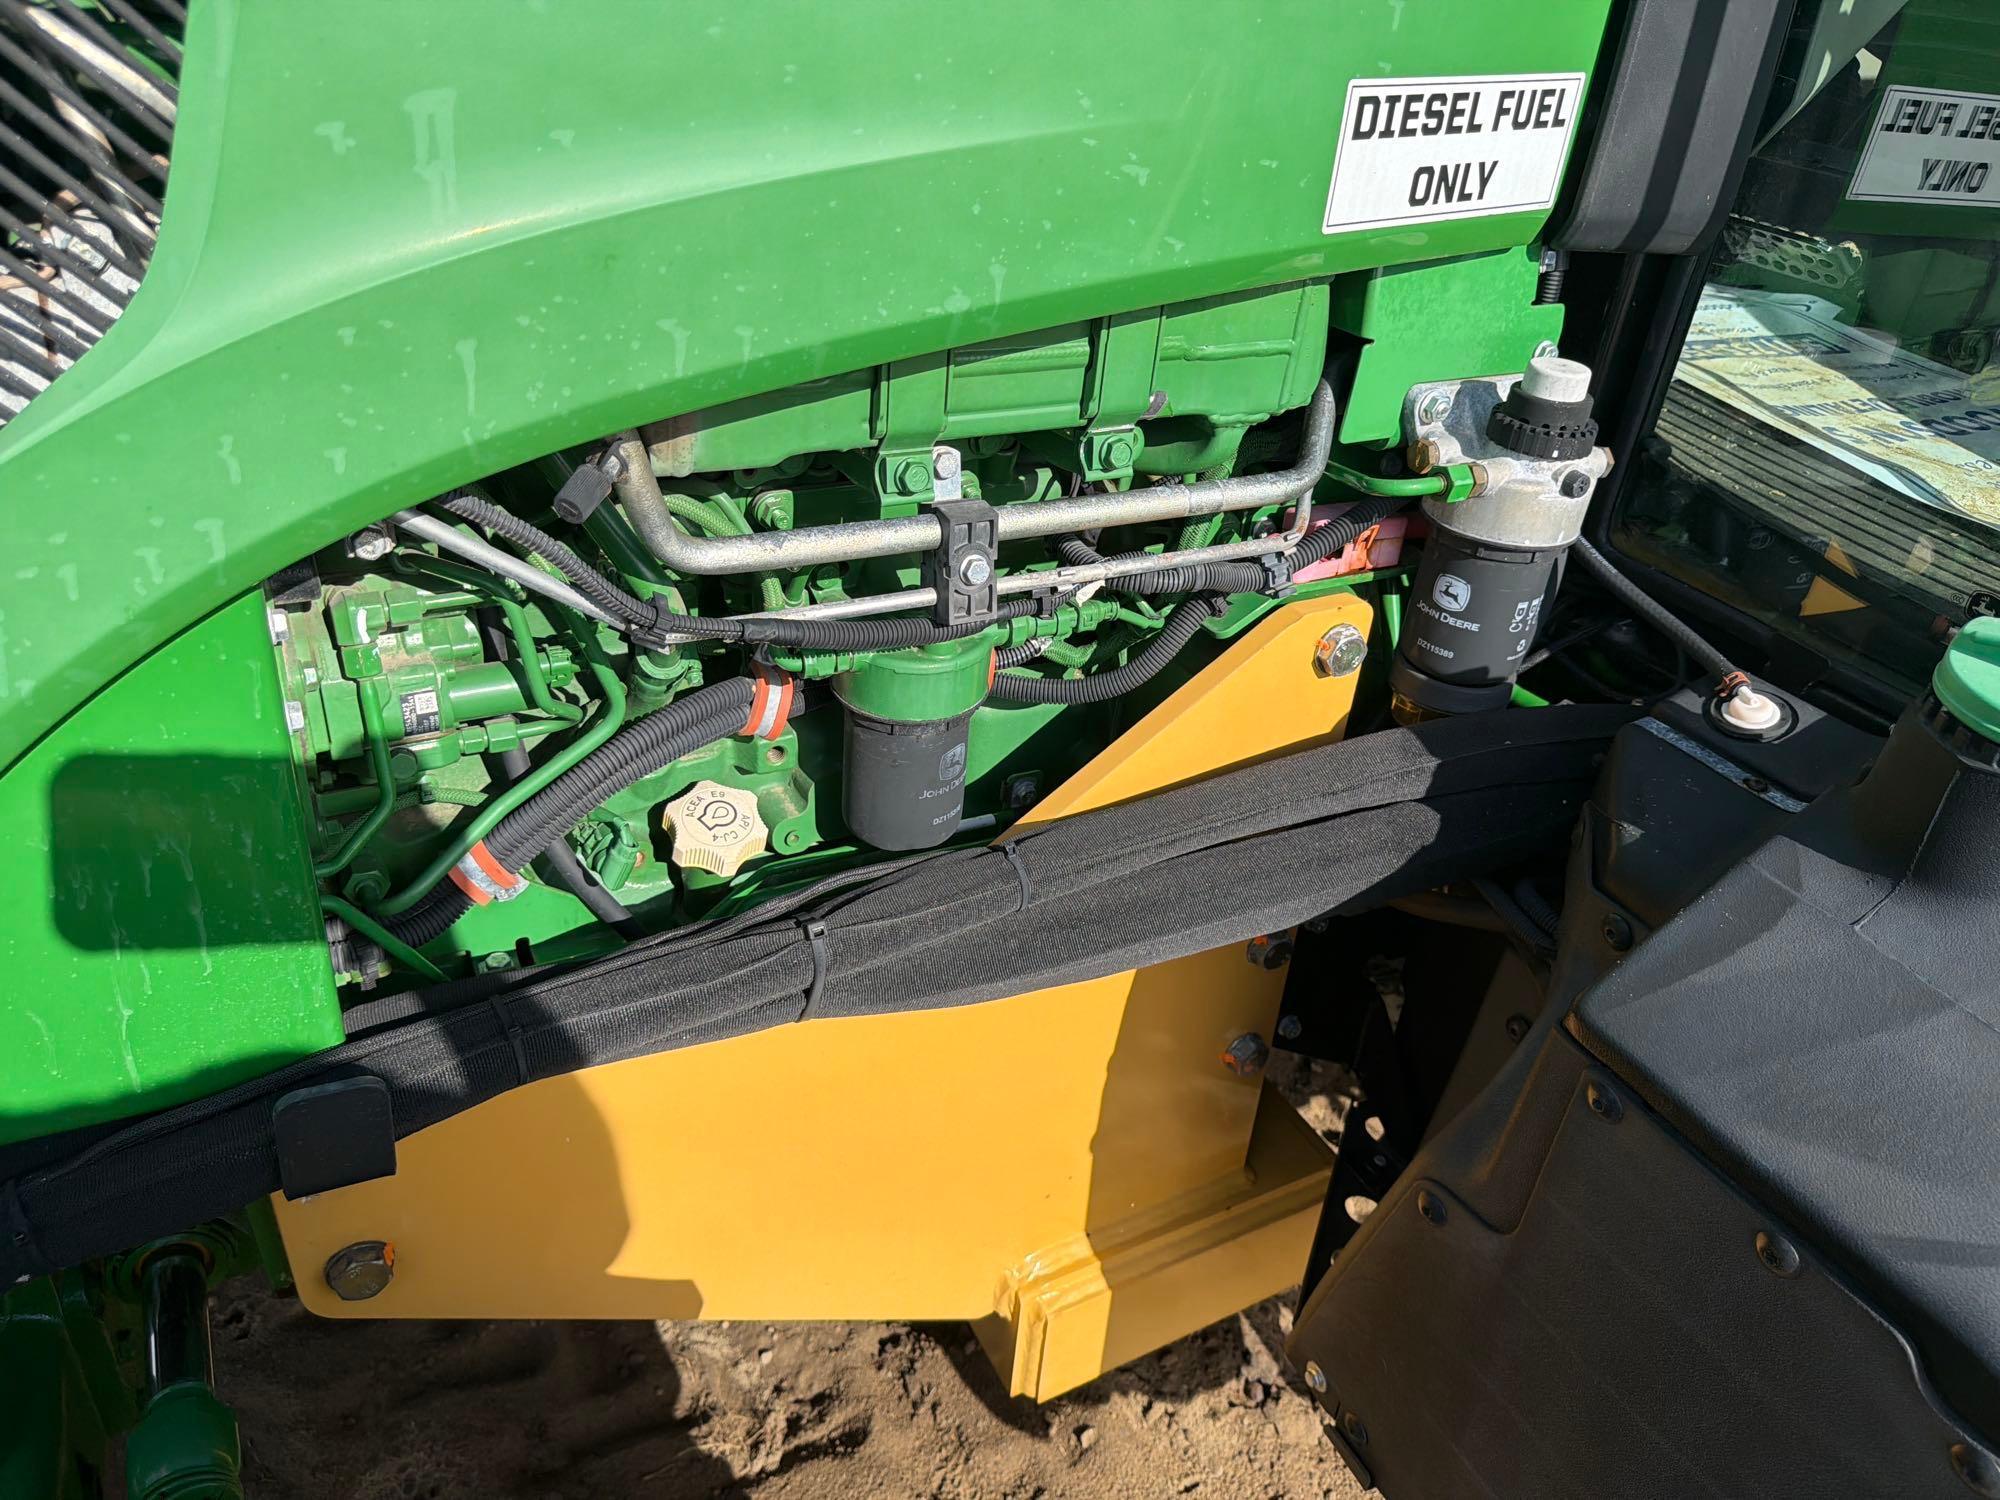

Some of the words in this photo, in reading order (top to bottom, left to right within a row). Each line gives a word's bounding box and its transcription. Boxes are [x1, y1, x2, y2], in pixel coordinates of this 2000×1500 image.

[1351, 91, 1483, 141] DIESEL
[1492, 88, 1567, 132] FUEL
[1408, 160, 1499, 207] ONLY
[1416, 600, 1440, 620] JOHN
[1440, 613, 1481, 632] DEERE
[685, 795, 706, 818] ACEA
[711, 790, 726, 798] E9
[918, 784, 950, 800] JOHN
[740, 812, 751, 831] API
[712, 830, 738, 842] CJ-4
